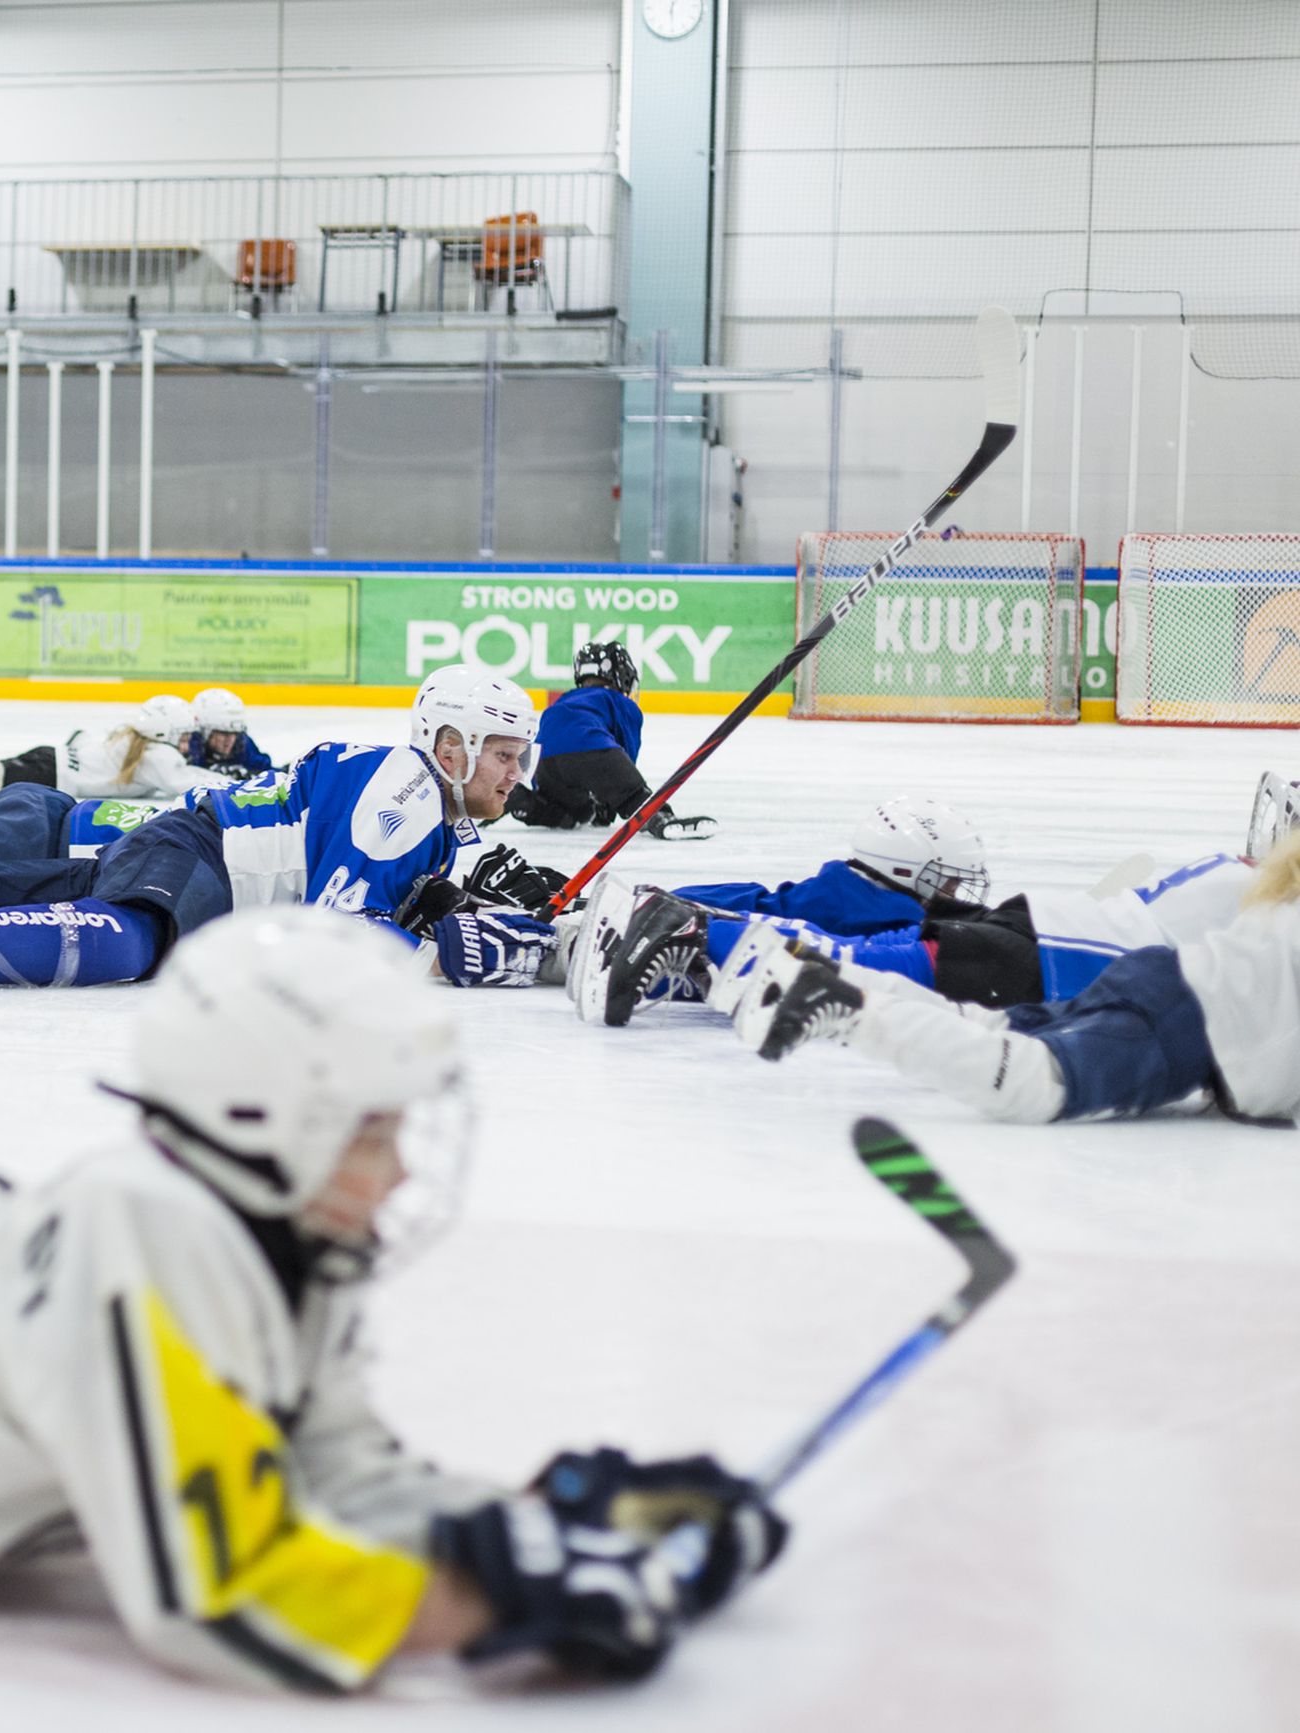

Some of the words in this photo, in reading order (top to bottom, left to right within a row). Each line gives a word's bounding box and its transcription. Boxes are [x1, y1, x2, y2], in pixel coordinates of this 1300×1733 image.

[462, 585, 576, 610] STRONG
[585, 587, 679, 611] WOOD
[874, 662, 1108, 689] HIRSITALO
[314, 865, 371, 912] 84
[454, 911, 485, 975] WARR
